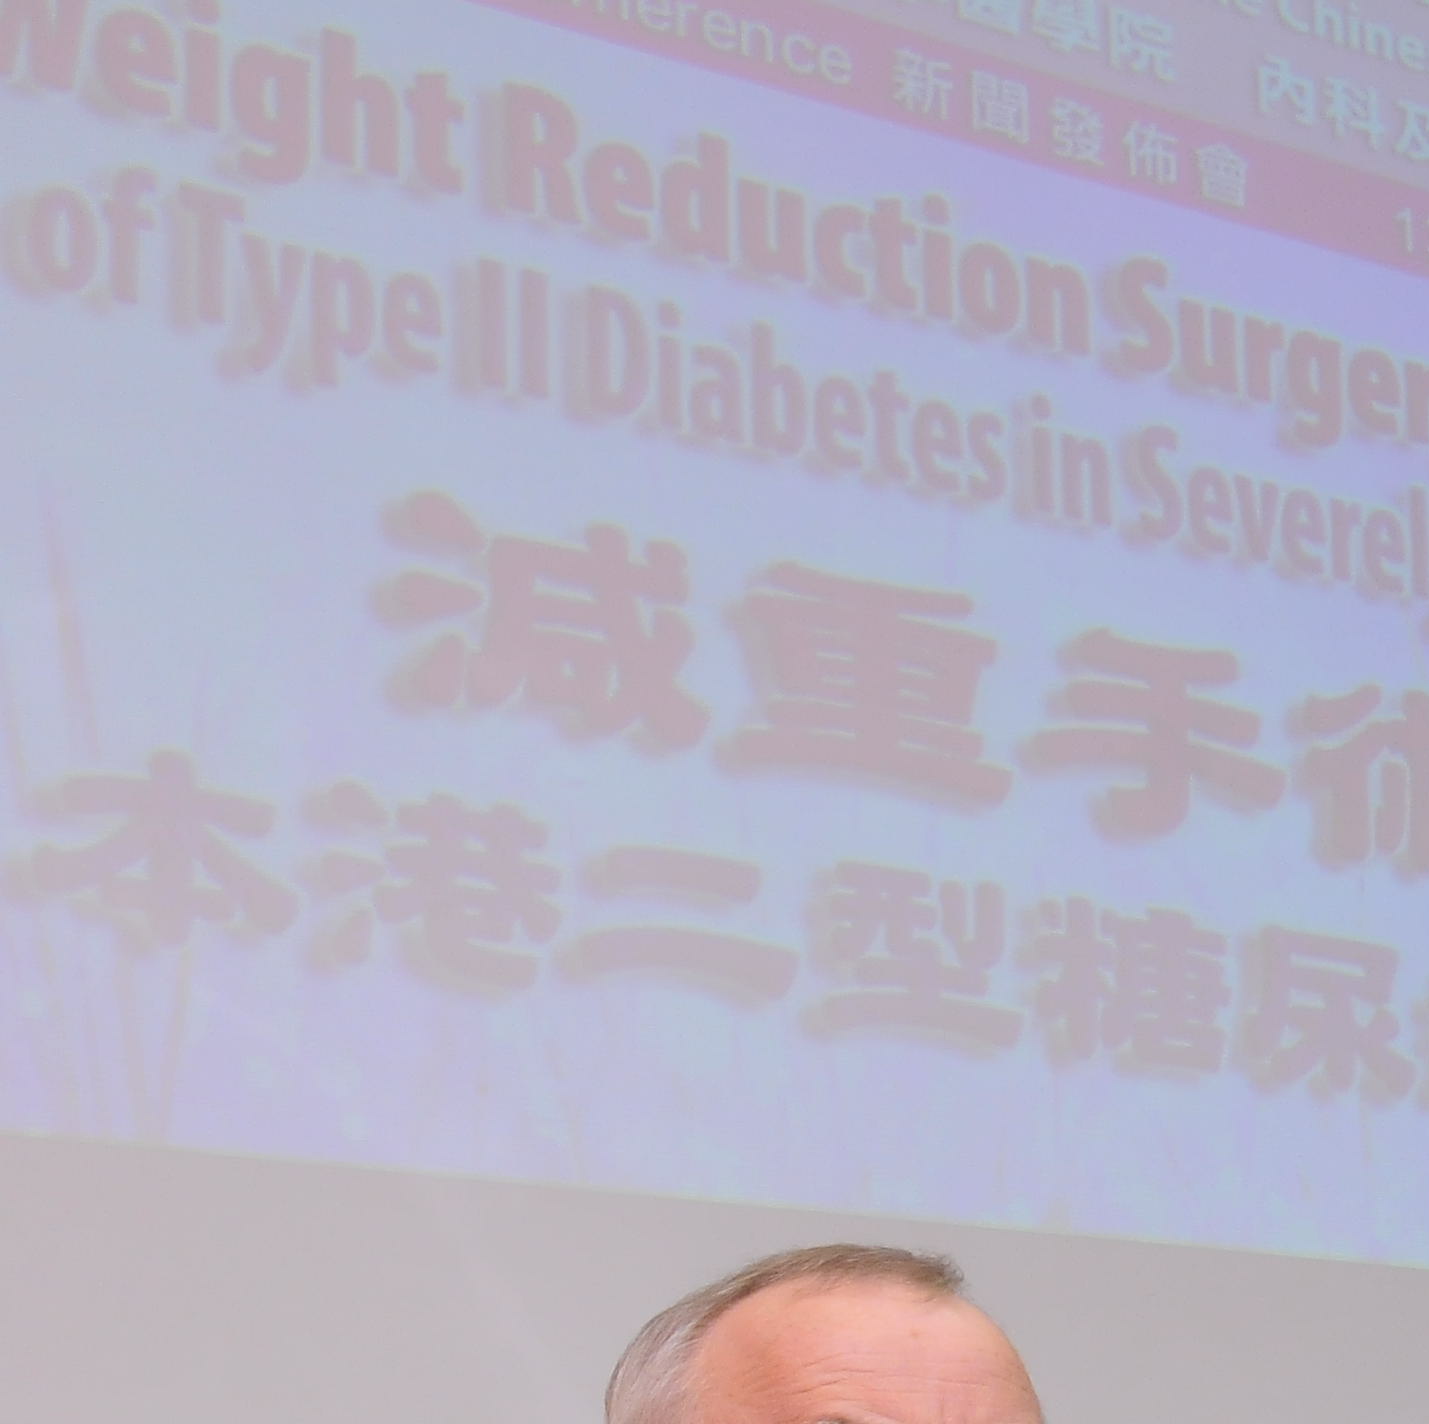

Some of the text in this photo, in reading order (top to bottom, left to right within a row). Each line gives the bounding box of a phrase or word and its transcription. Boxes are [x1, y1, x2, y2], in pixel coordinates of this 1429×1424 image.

[570, 0, 854, 85] erence
[27, 167, 155, 304] of
[177, 181, 442, 386] Type
[478, 257, 549, 396] II
[587, 285, 1003, 500] Diabetes
[1028, 395, 1111, 527] in
[500, 80, 1091, 356] Reduction
